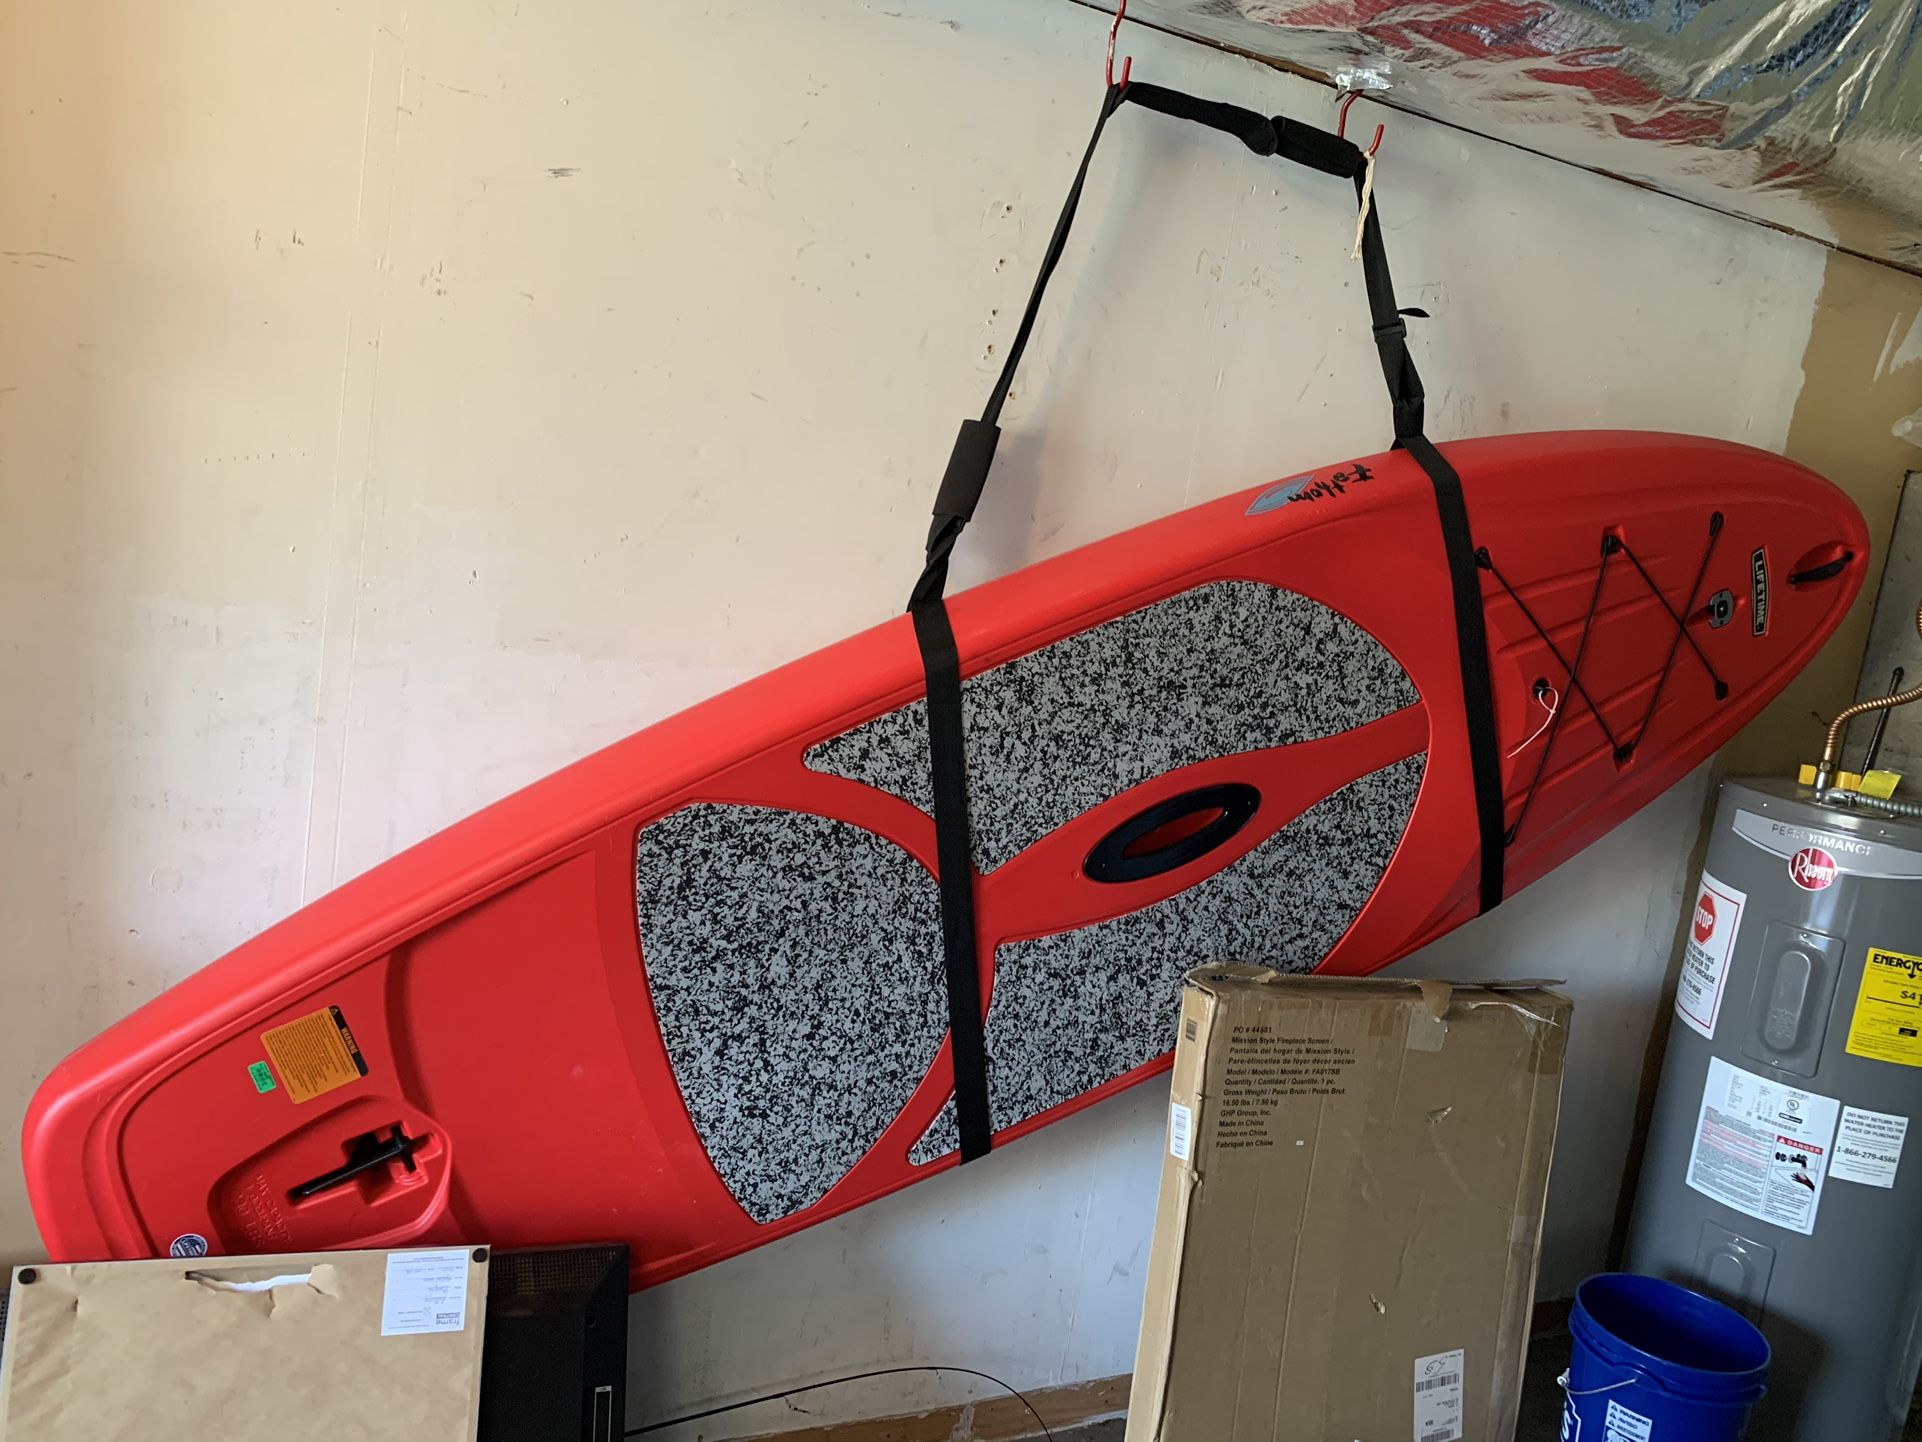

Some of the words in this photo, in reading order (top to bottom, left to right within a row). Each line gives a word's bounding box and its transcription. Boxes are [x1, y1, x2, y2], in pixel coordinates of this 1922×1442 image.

[1754, 559, 1767, 626] LIFETIME
[1794, 848, 1834, 885] Rheem
[1695, 907, 1714, 930] STOP
[1233, 1026, 1244, 1034] PO
[1259, 1037, 1275, 1046] Style
[1277, 1038, 1306, 1046] Fireplace
[1272, 1048, 1294, 1056] hogar
[1304, 1047, 1332, 1055] Mission
[1333, 1048, 1351, 1056] Style
[1292, 1058, 1311, 1066] foyer
[1226, 1068, 1247, 1076] Model
[1251, 1068, 1276, 1076] Modelo
[1224, 1078, 1253, 1087] Quantity
[1223, 1088, 1243, 1096] Gross
[1244, 1088, 1268, 1097] Weight
[1311, 1087, 1330, 1095] Poids
[1270, 1099, 1279, 1107] kg
[1220, 1109, 1236, 1117] GHP
[1844, 1118, 1865, 1127] WATER
[1864, 1121, 1886, 1131] HEATER
[1870, 1116, 1893, 1126] RETURN
[1217, 1130, 1239, 1138] Hecho
[1248, 1129, 1268, 1137] China
[1845, 1125, 1863, 1133] PLACE
[1872, 1131, 1901, 1140] PURCHASE
[1254, 1139, 1274, 1147] Chine
[1786, 1140, 1822, 1154] DANGER
[1836, 1145, 1898, 1164] 1-866-279-4566
